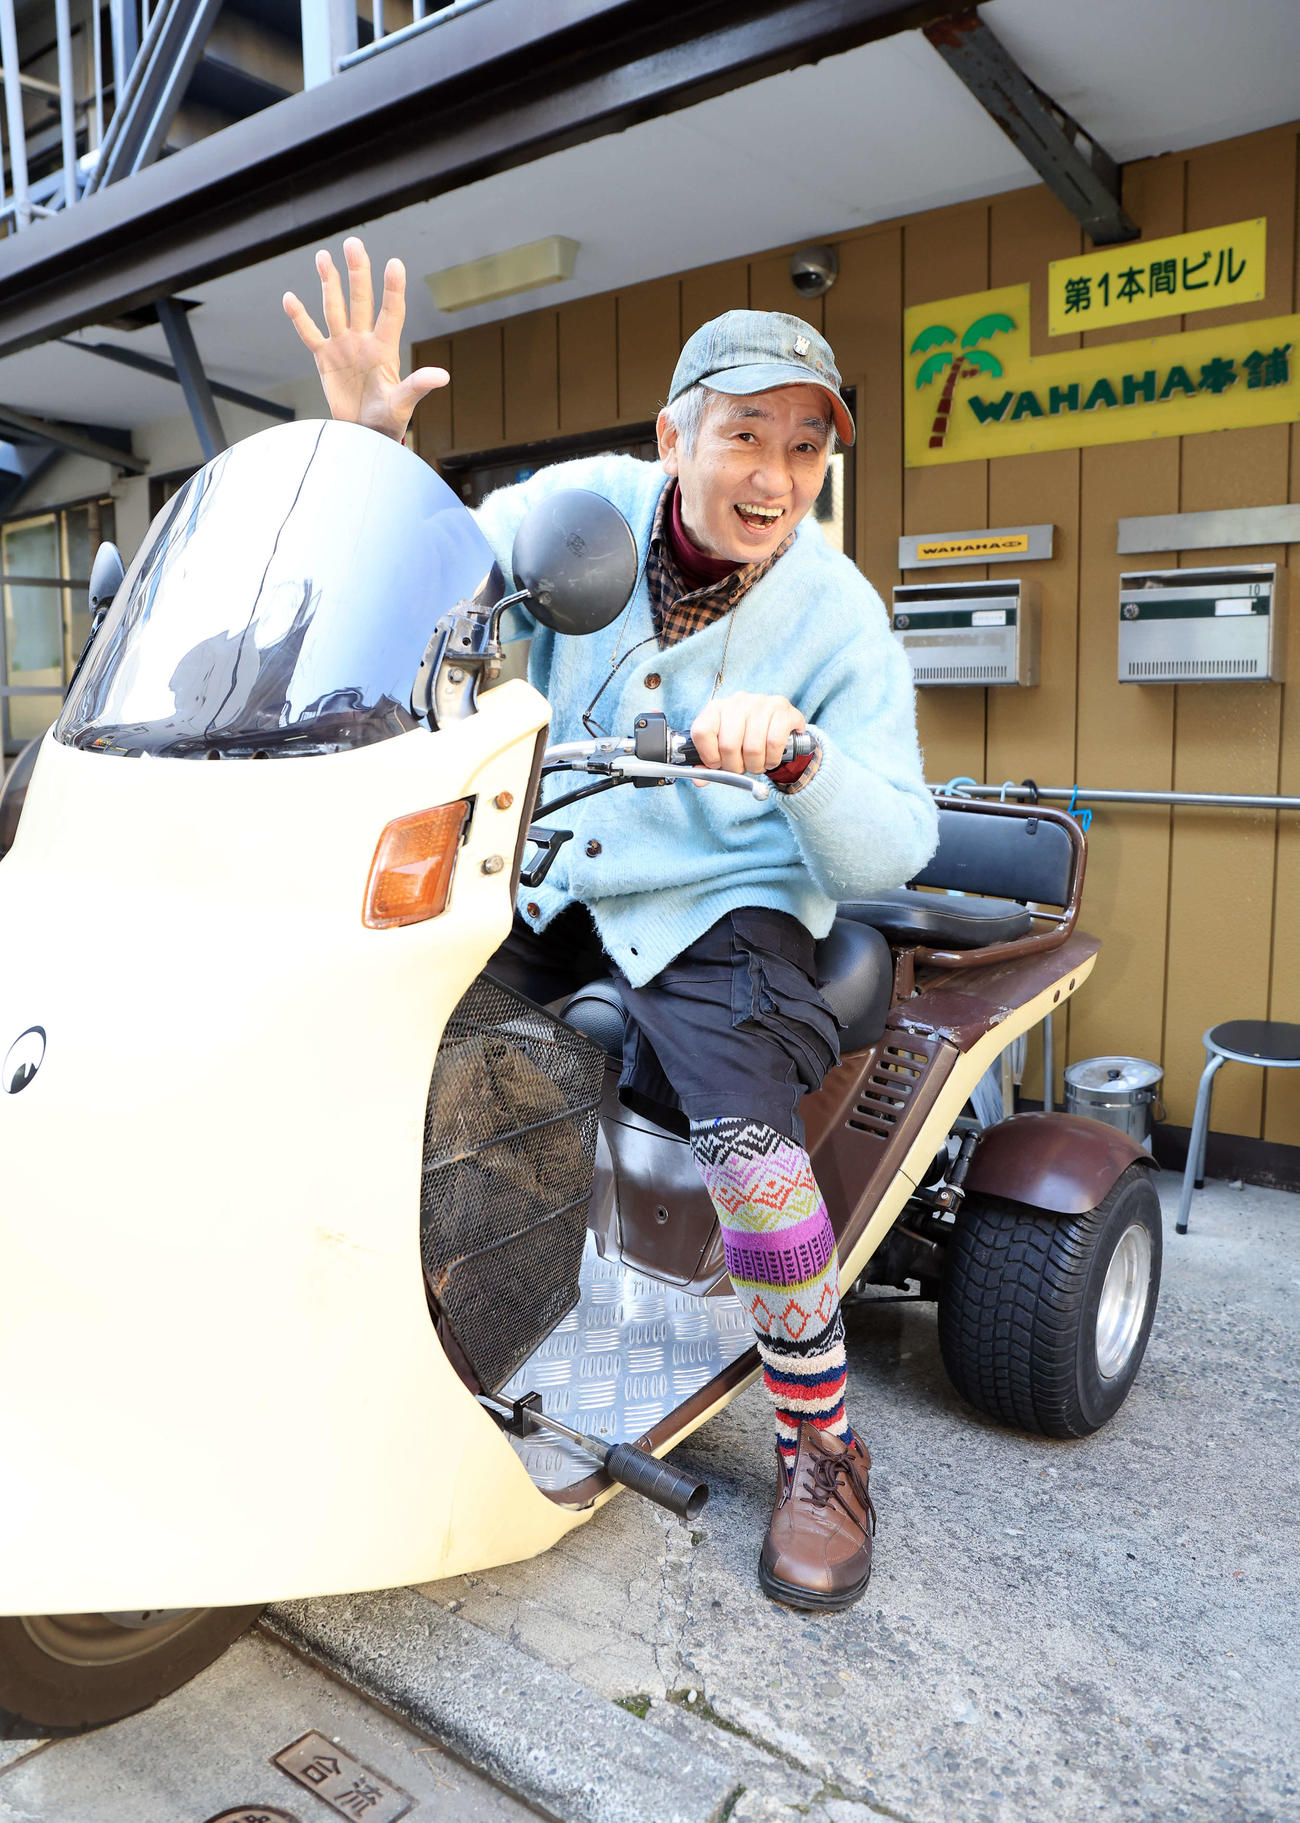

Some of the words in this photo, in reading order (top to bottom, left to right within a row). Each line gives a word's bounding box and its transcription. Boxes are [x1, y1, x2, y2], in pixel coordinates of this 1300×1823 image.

[1064, 248, 1246, 314] 第1本間ビル
[300, 1756, 383, 1818] 合流
